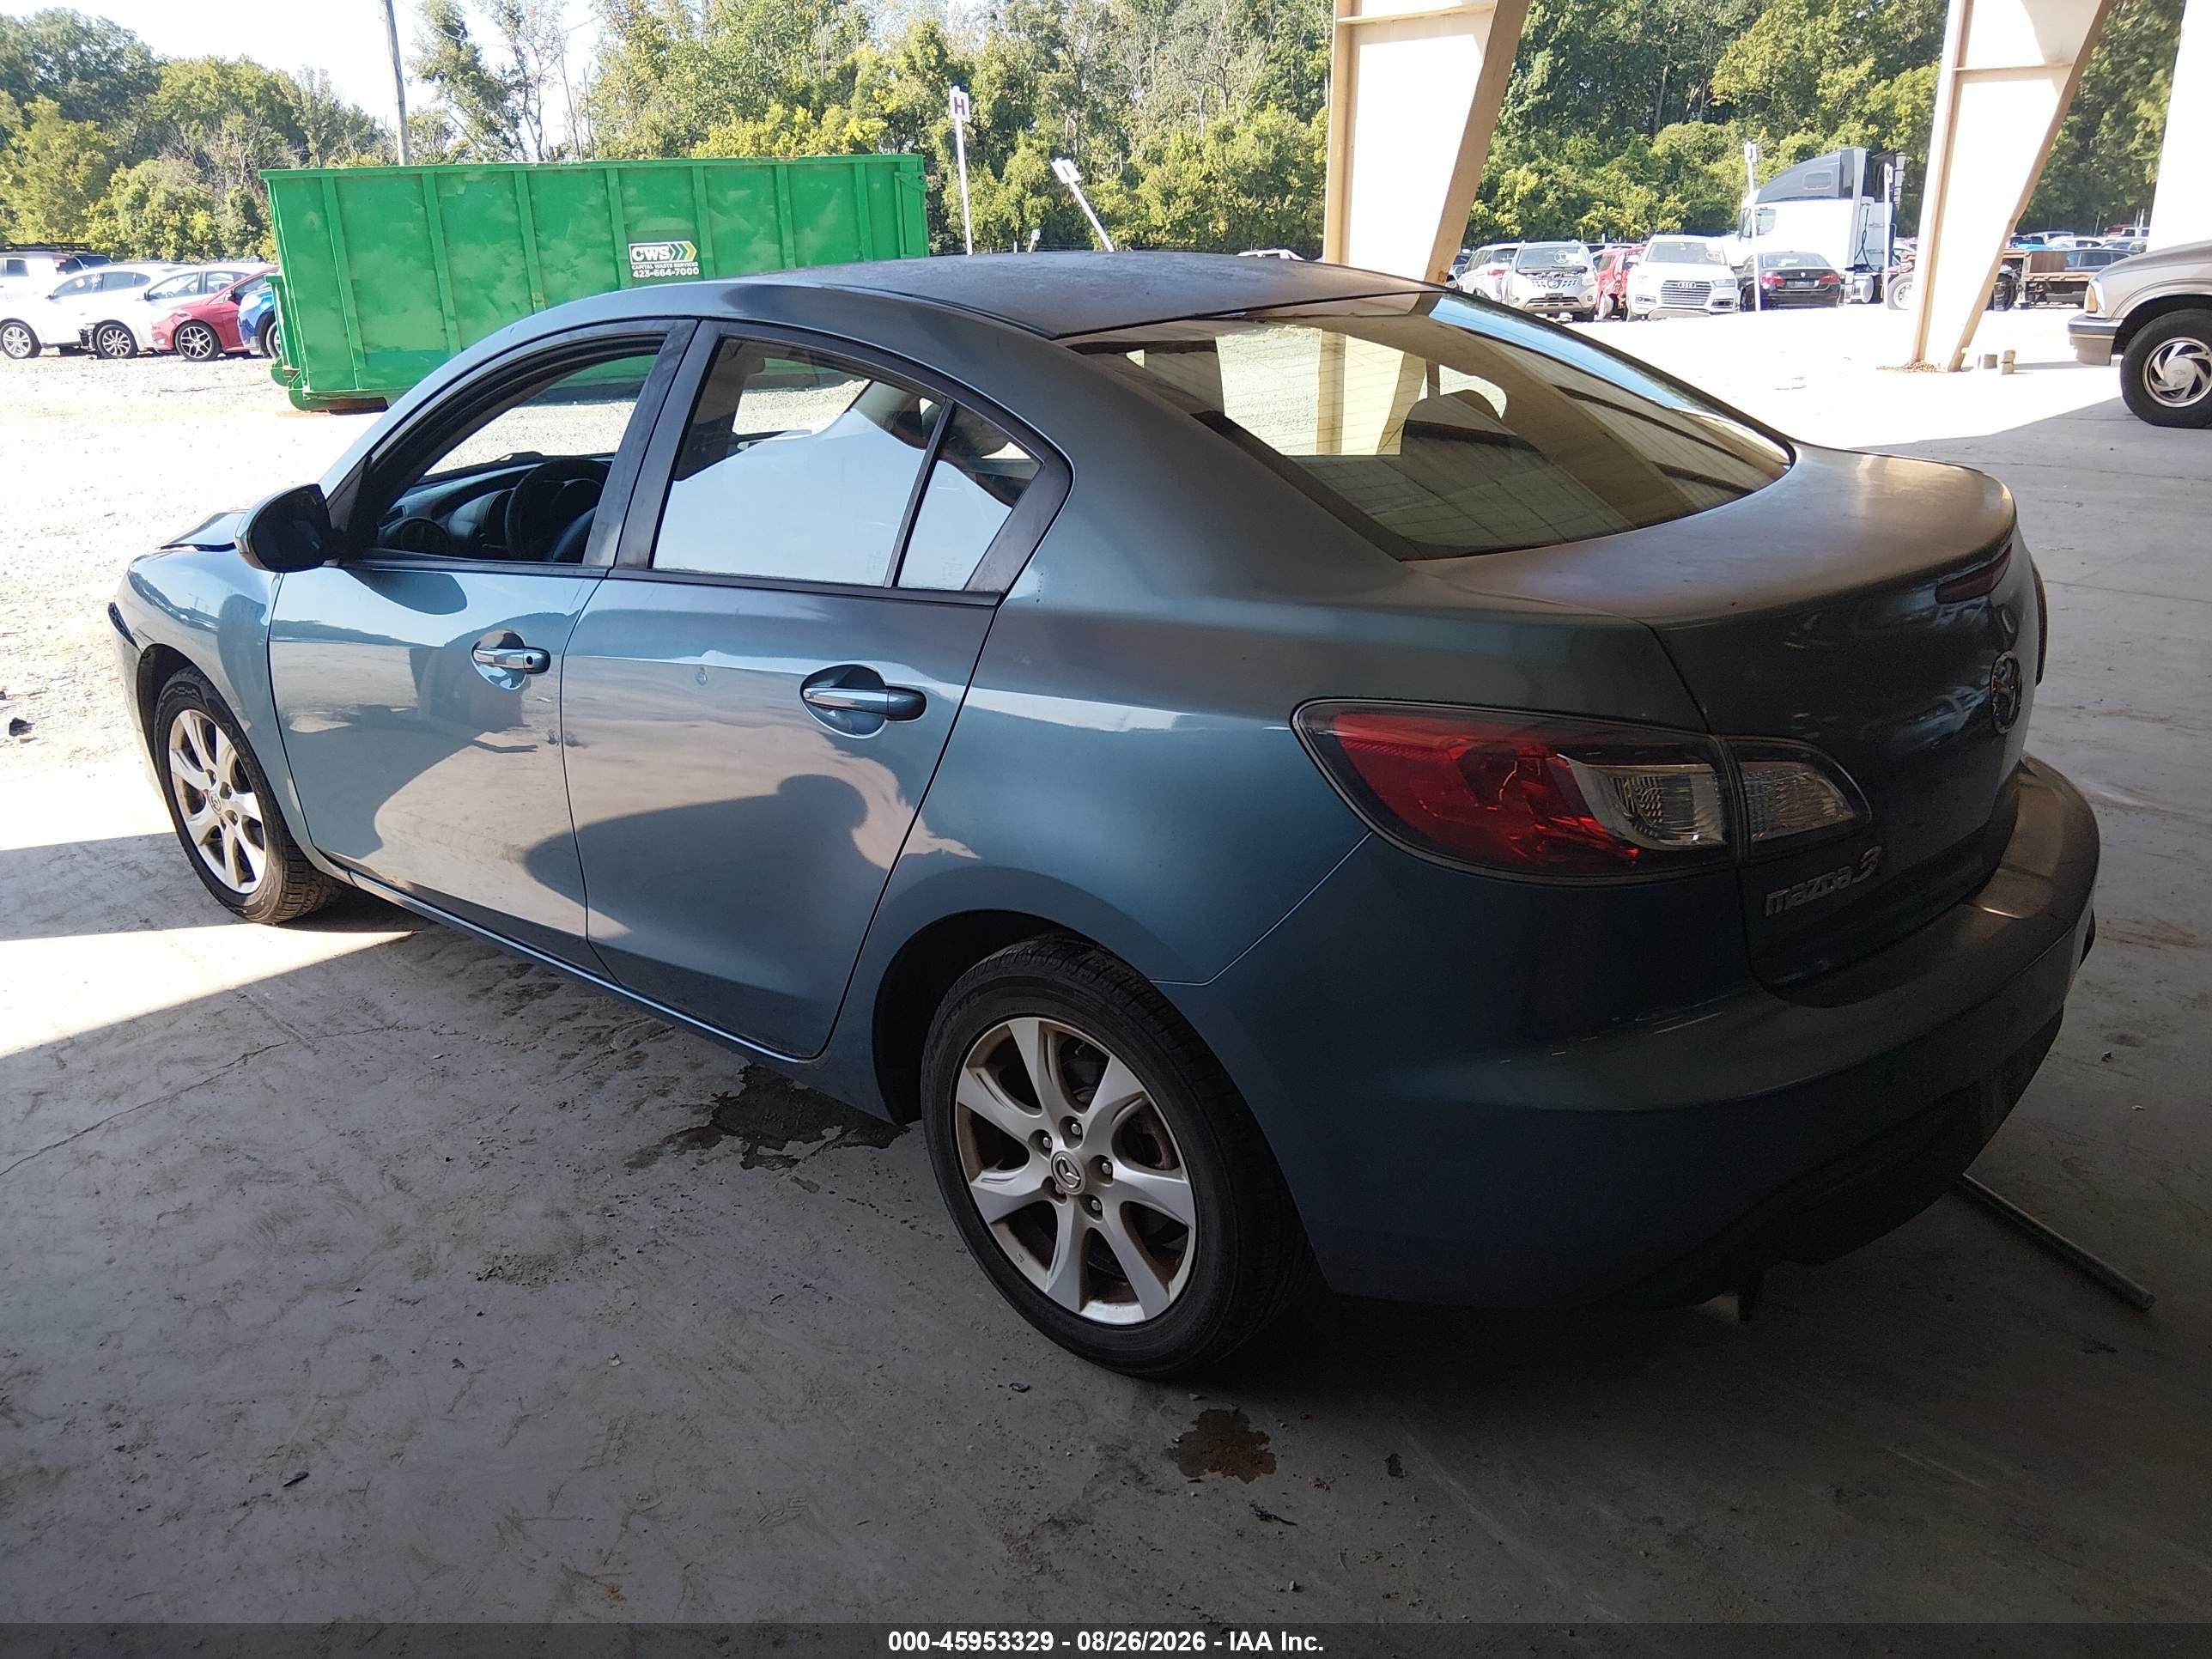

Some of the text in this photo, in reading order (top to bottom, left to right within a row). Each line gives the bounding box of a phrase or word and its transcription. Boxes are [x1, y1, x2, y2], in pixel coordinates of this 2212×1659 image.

[954, 96, 965, 116] H
[631, 246, 670, 261] CWS
[633, 267, 699, 277] 423-664-7000
